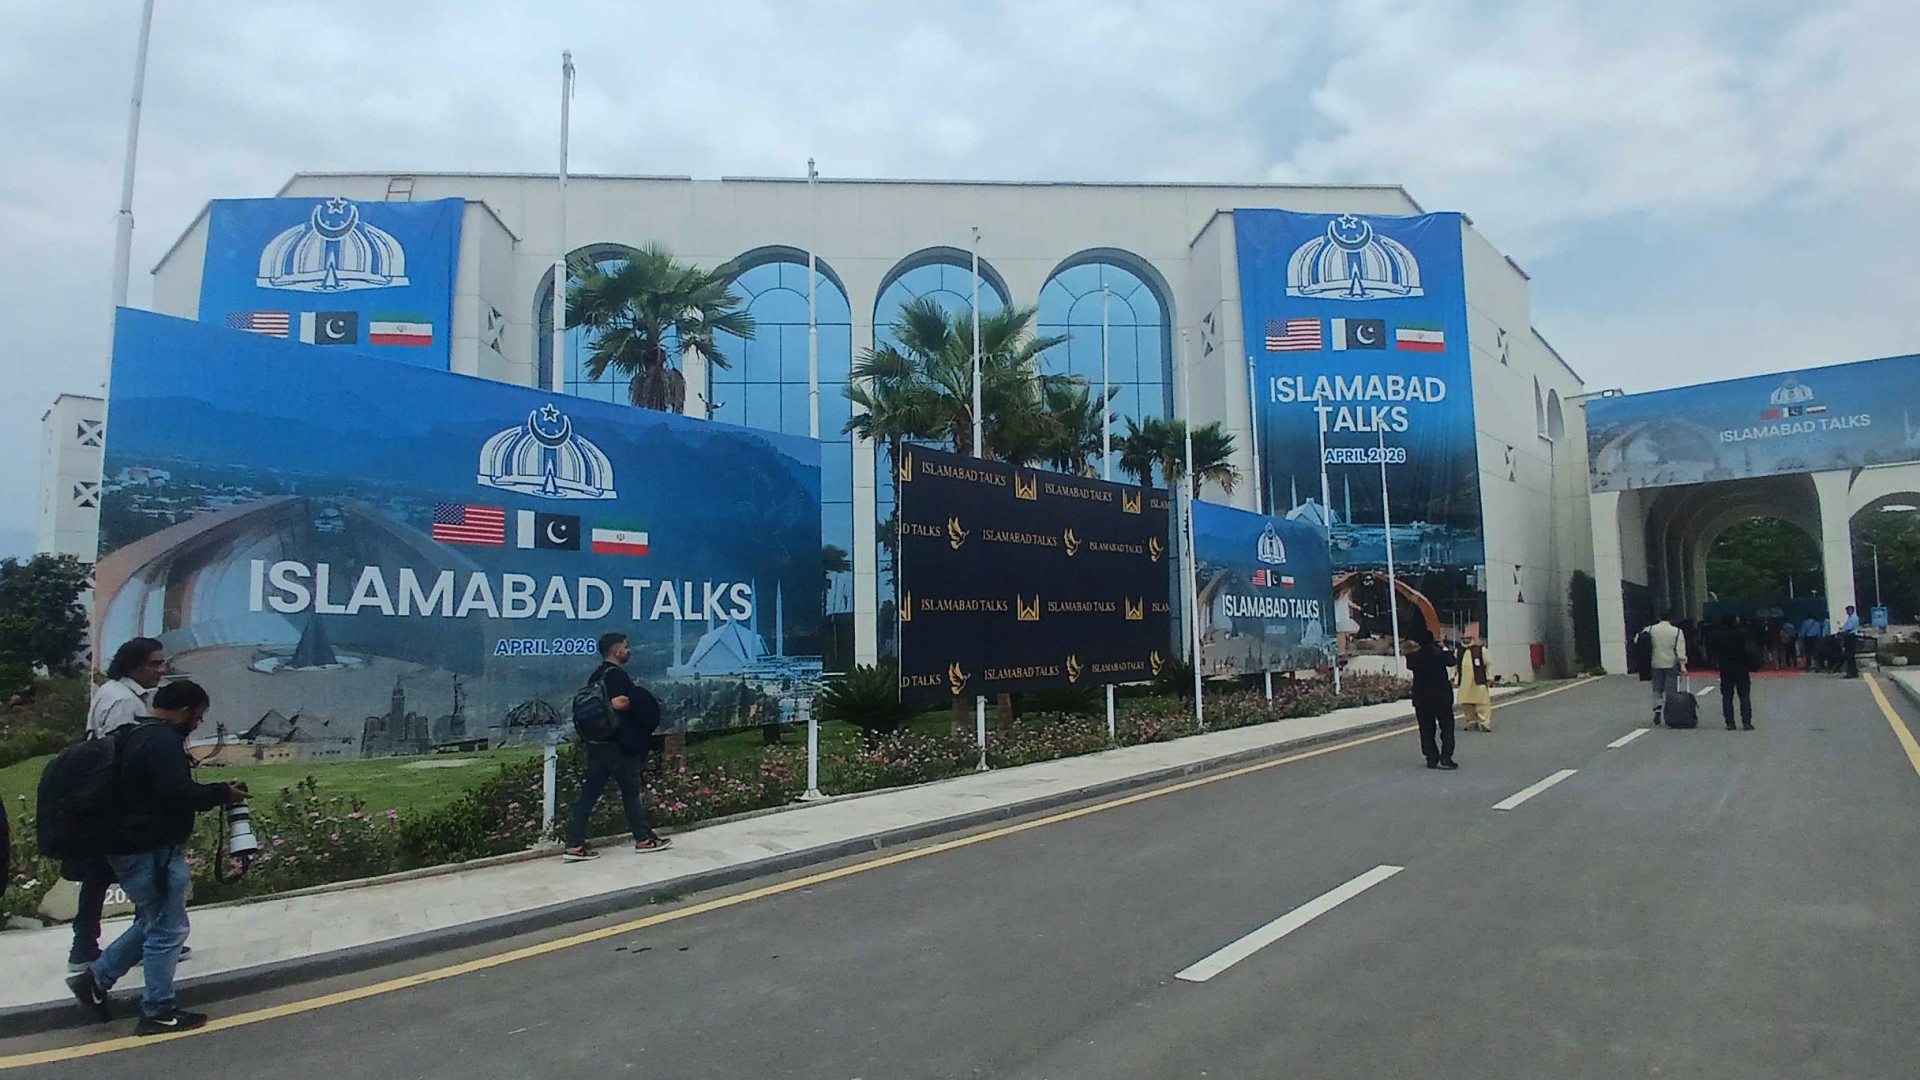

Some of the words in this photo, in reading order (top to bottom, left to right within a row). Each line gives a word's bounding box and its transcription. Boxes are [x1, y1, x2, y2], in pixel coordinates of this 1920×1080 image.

[1270, 375, 1446, 403] ISLAMABAD
[1313, 406, 1409, 433] TALKS
[1719, 421, 1815, 442] ISLAMABAD
[1818, 414, 1871, 431] TALKS
[1324, 448, 1368, 463] APRIL
[1367, 447, 1407, 464] 2026
[921, 461, 977, 481] ISLAMABAD
[978, 472, 1006, 486] TALKS
[1045, 483, 1089, 499] ISLAMABAD
[1089, 490, 1112, 501] TALKS
[911, 523, 941, 537] TALKS
[983, 529, 1032, 544] ISLAMABAD
[1032, 535, 1057, 547] TALKS
[1089, 542, 1125, 552] ISLAMABAD
[1125, 544, 1143, 554] TALKS
[249, 559, 613, 620] ISLAMABAD
[623, 578, 753, 621] TALKS
[921, 599, 979, 611] ISLAMABAD
[980, 600, 1008, 611] TALKS
[1048, 601, 1093, 612] ISLAMABAD
[1093, 602, 1115, 612] TALKS
[1222, 594, 1289, 618] ISLAMABAD
[1289, 599, 1320, 618] TALKS
[494, 639, 550, 655] APRIL
[552, 638, 597, 655] 2026
[984, 667, 1035, 680] ISLAMABAD
[1035, 665, 1060, 676] TALKS
[1091, 663, 1127, 672] ISLAMABAD
[911, 674, 941, 686] TALKS
[104, 889, 131, 905] 20
